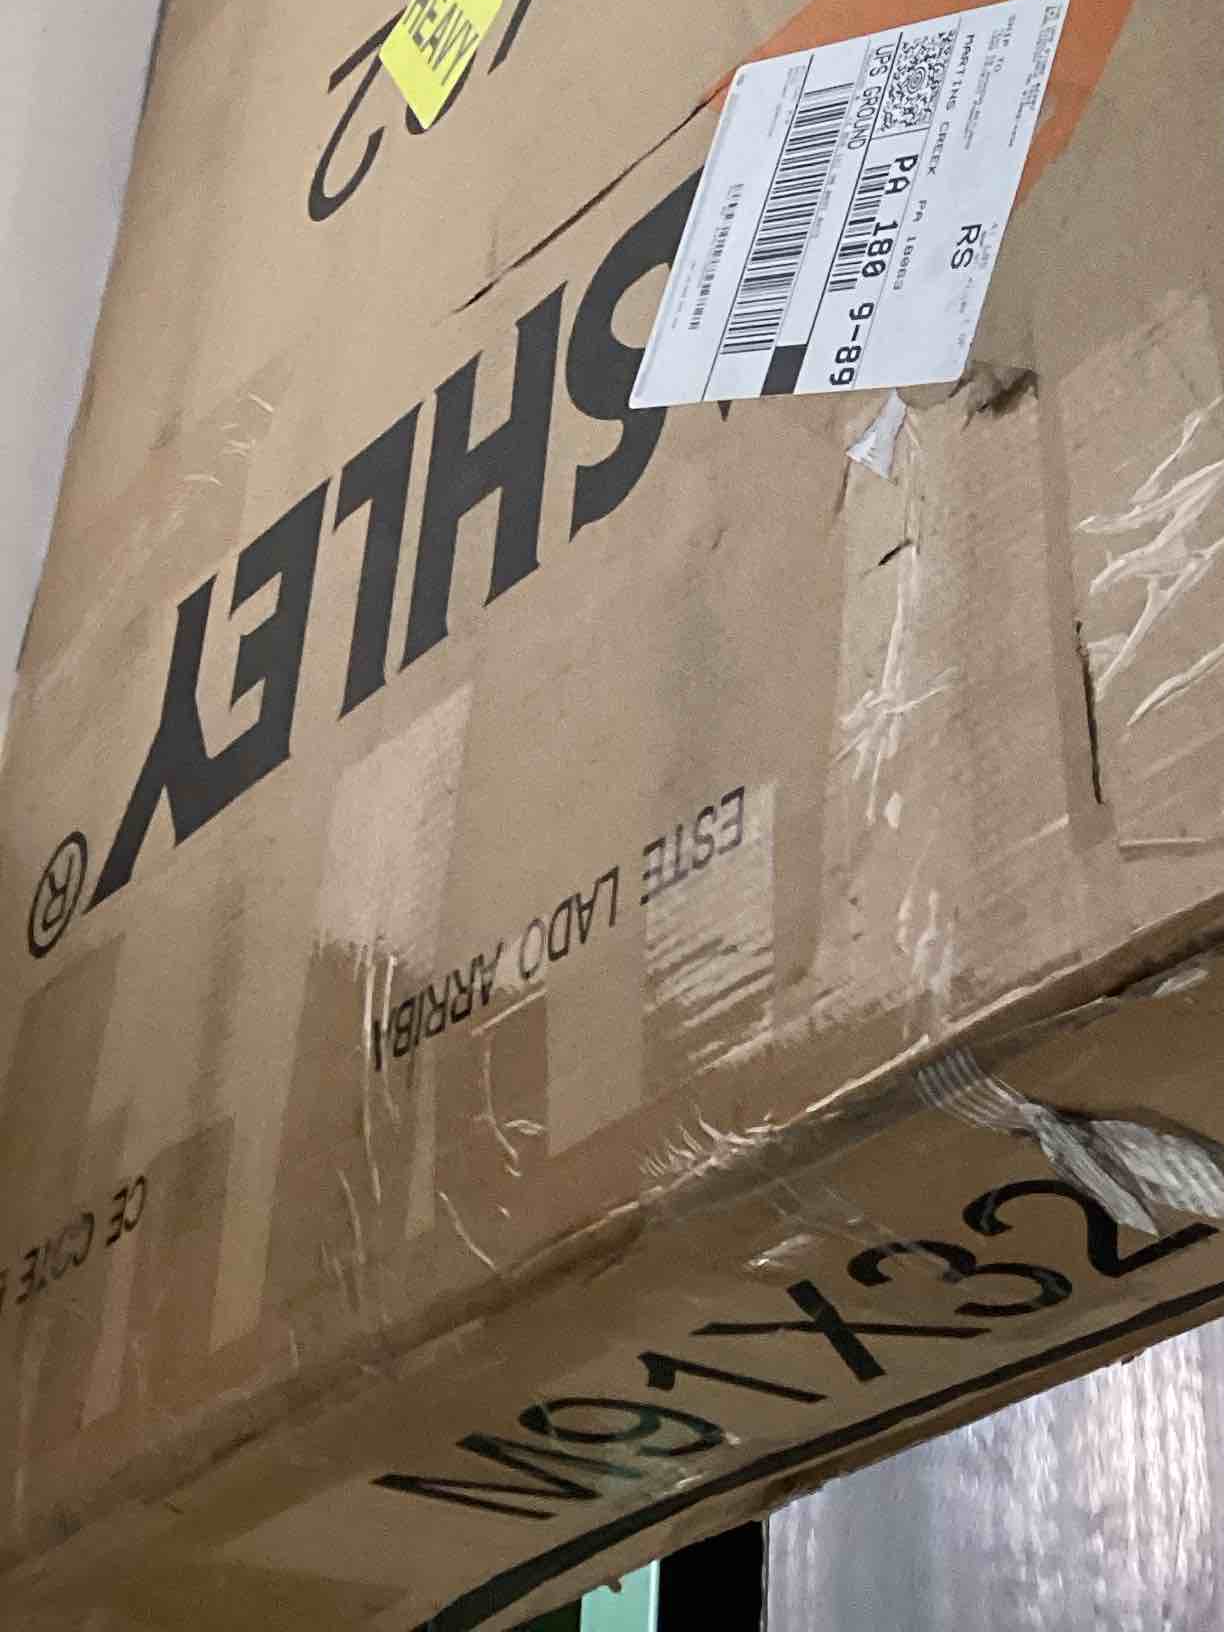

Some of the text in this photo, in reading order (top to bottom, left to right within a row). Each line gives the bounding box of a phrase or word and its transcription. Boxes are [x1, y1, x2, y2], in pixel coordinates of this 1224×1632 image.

[849, 43, 893, 148] UPS GROUND
[946, 33, 975, 110] MARTINS
[927, 121, 949, 174] CREEK
[829, 154, 916, 384] PA 180 9-89
[950, 225, 979, 269] RS
[83, 165, 733, 914] SHLEY
[640, 787, 746, 907] ESTE
[520, 866, 621, 980] LADO
[371, 1178, 1219, 1520] M91X32
